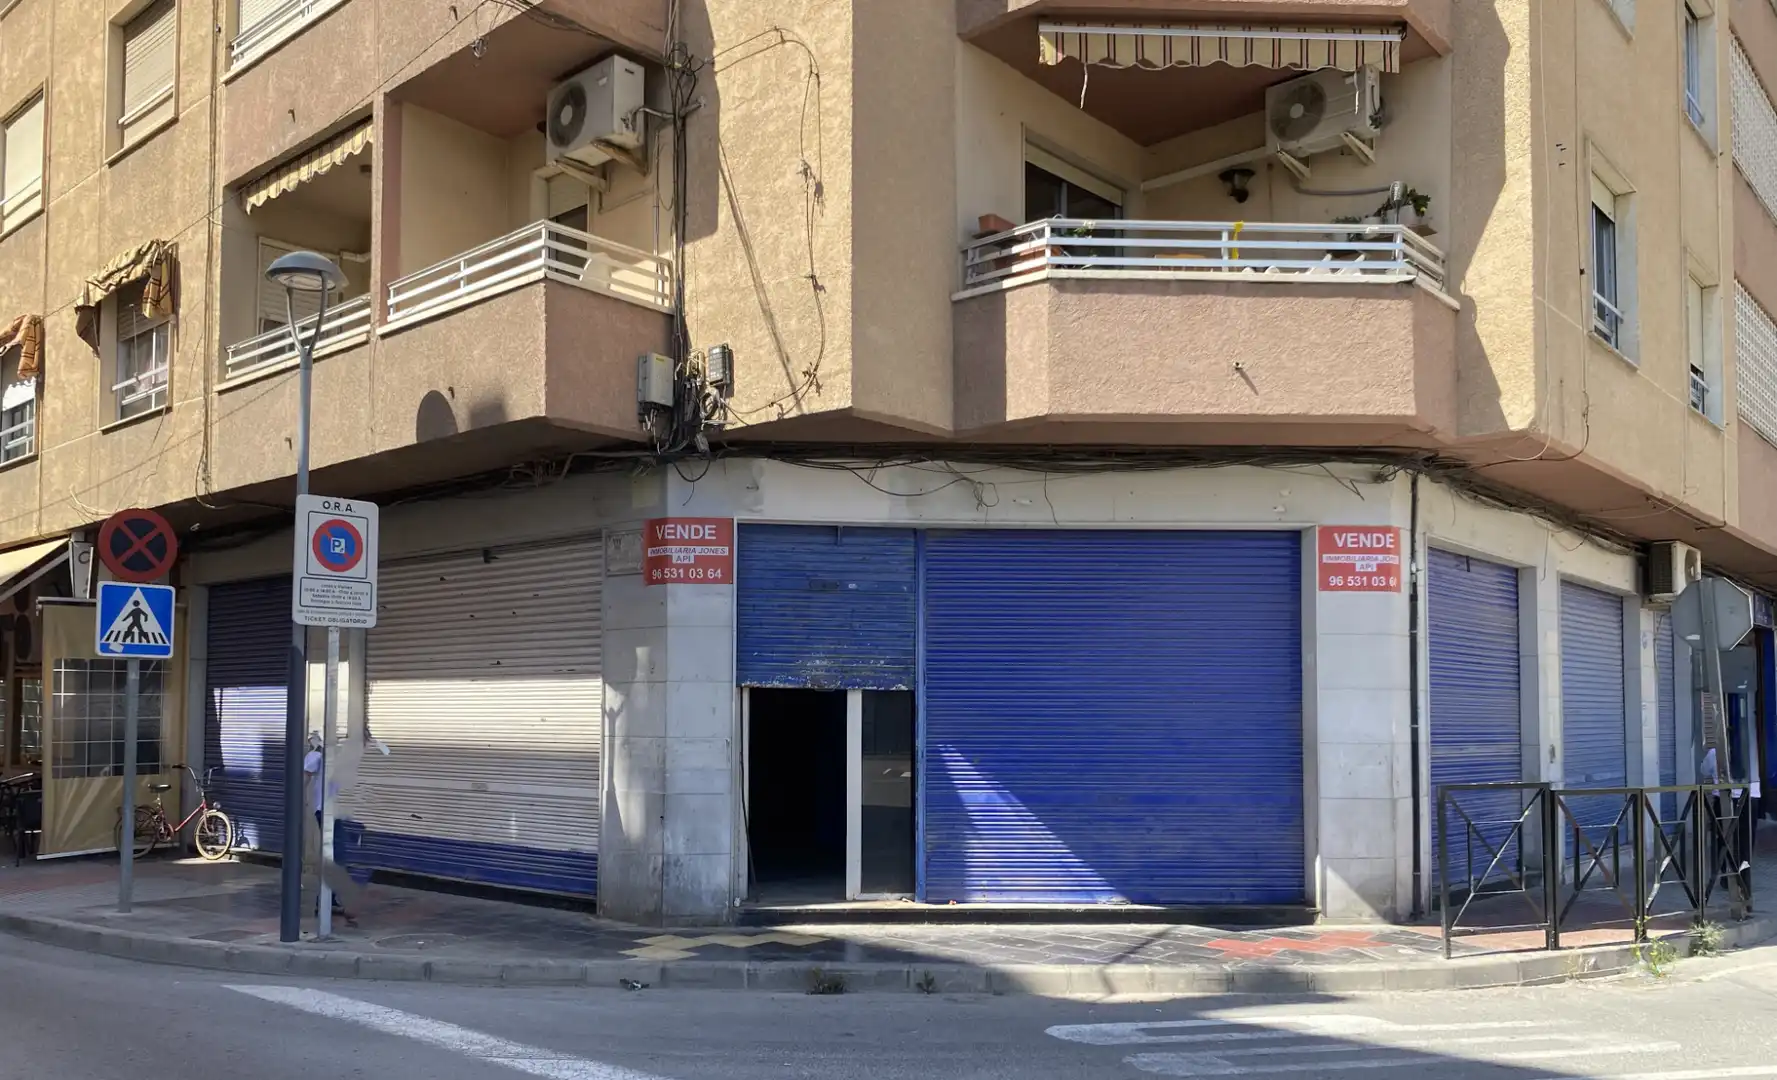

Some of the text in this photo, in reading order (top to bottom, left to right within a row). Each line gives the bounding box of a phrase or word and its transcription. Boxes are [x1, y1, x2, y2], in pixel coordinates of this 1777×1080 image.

[322, 500, 357, 513] O.R.A.
[655, 524, 717, 540] VENDE
[1333, 532, 1395, 548] VENDE
[698, 547, 726, 555] JONES
[675, 555, 691, 563] API
[652, 567, 722, 580] 96 531 03 64
[1328, 575, 1344, 587] 96
[1347, 575, 1367, 587] 531
[1371, 576, 1386, 587] 03
[304, 615, 367, 625] TICKET OBLIGATORIO
